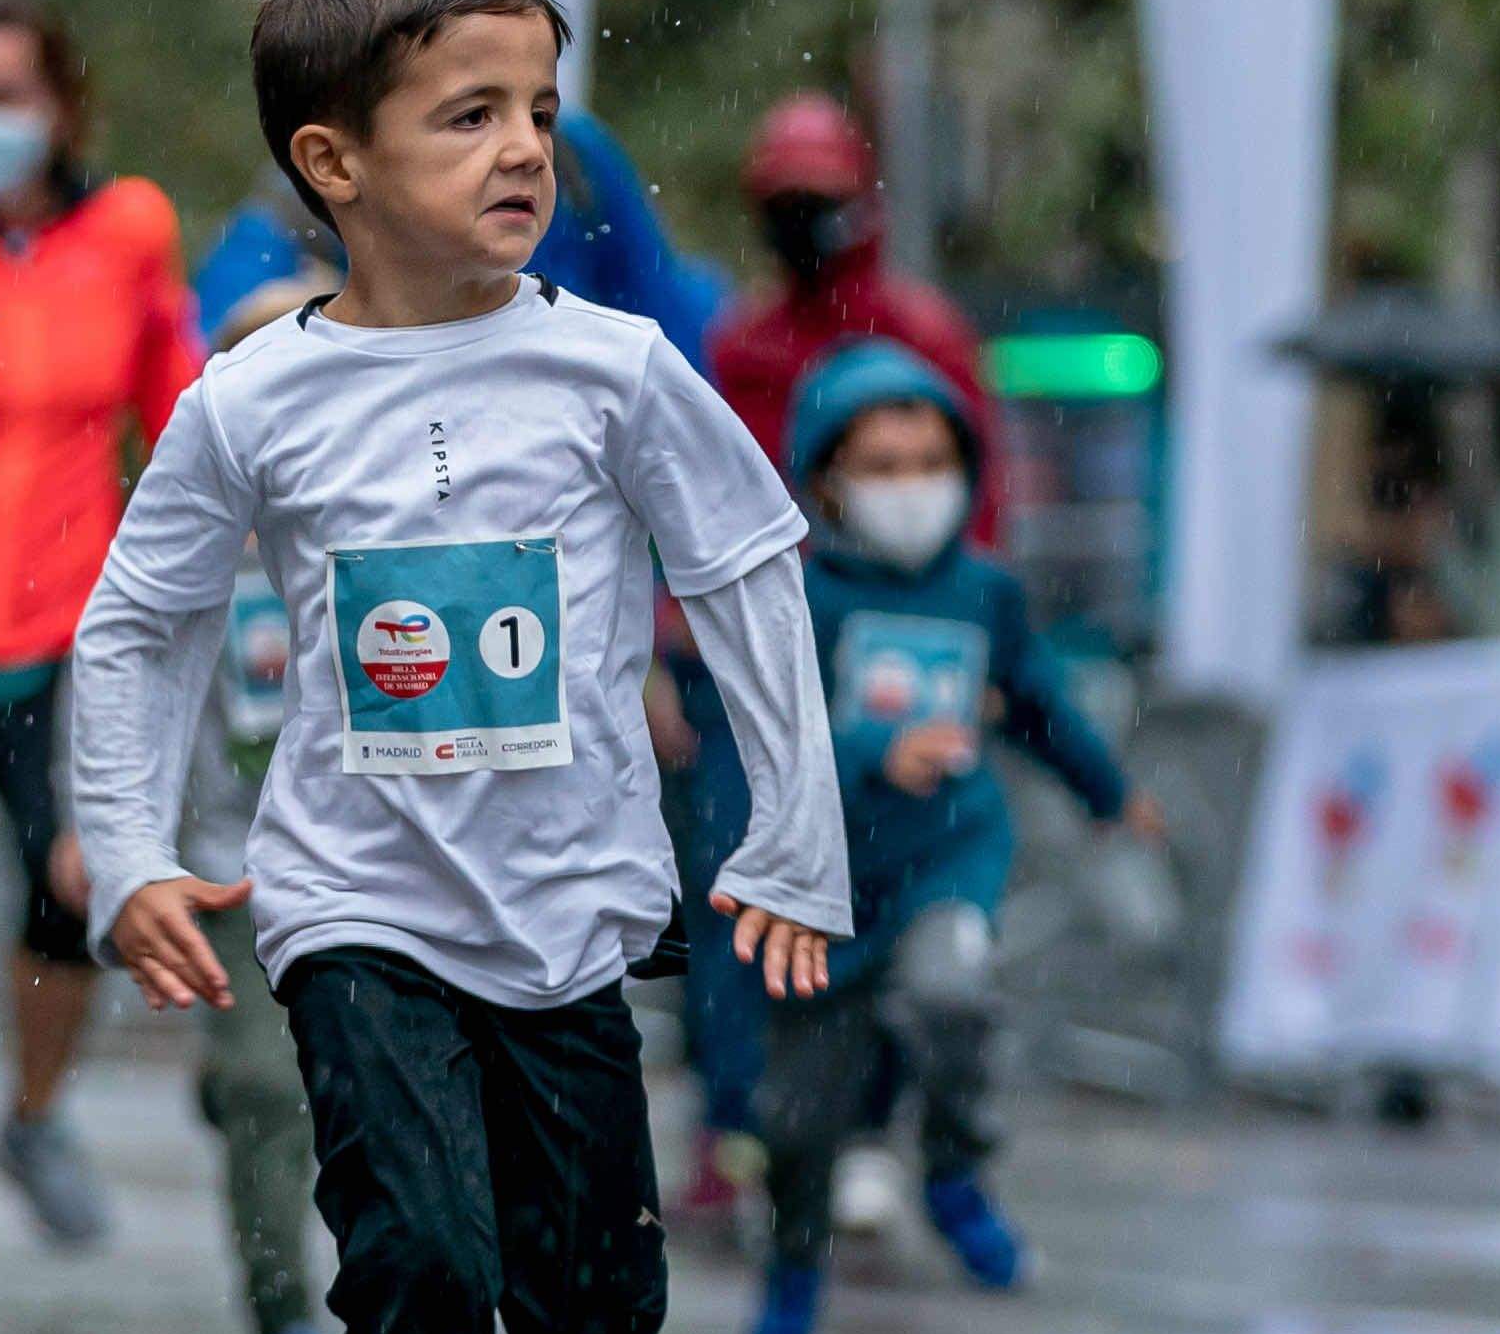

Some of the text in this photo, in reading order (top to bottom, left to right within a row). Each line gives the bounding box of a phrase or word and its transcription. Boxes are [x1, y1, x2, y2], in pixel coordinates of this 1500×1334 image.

[429, 422, 451, 501] KIPSTA
[500, 616, 519, 668] 1
[376, 747, 422, 758] MADRID
